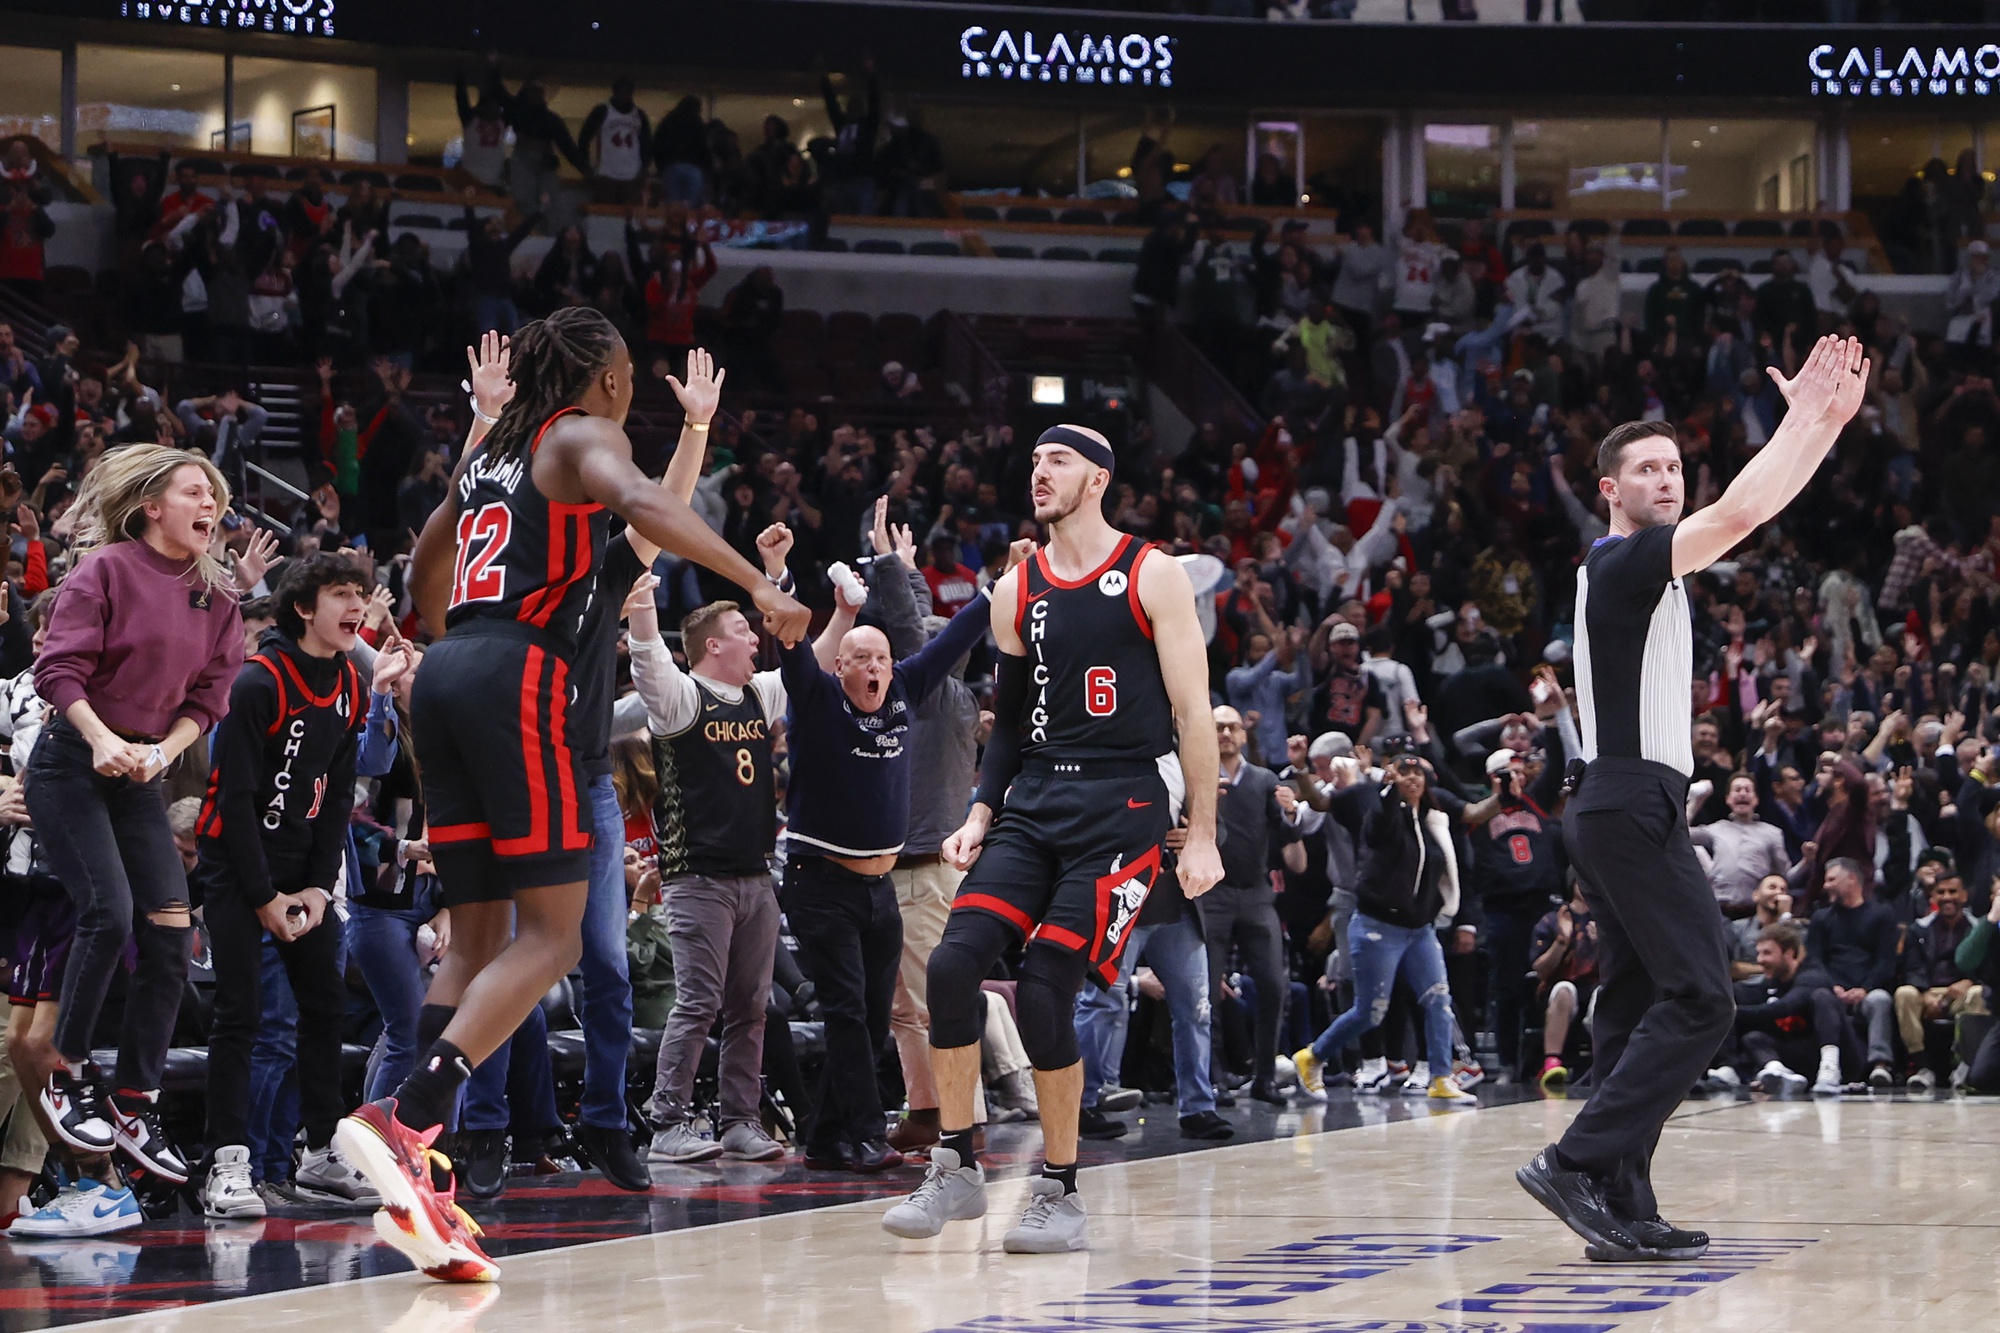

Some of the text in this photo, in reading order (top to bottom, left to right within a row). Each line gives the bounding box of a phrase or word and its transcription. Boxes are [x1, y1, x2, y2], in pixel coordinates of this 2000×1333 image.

[960, 26, 1173, 70] CALAMOS
[448, 501, 513, 609] 12
[1030, 600, 1051, 743] CHICAGO
[1084, 665, 1117, 717] 6
[263, 719, 305, 830] CHICAO
[736, 748, 755, 787] 8
[1508, 834, 1533, 865] 8
[1038, 1233, 1503, 1307] CENTER
